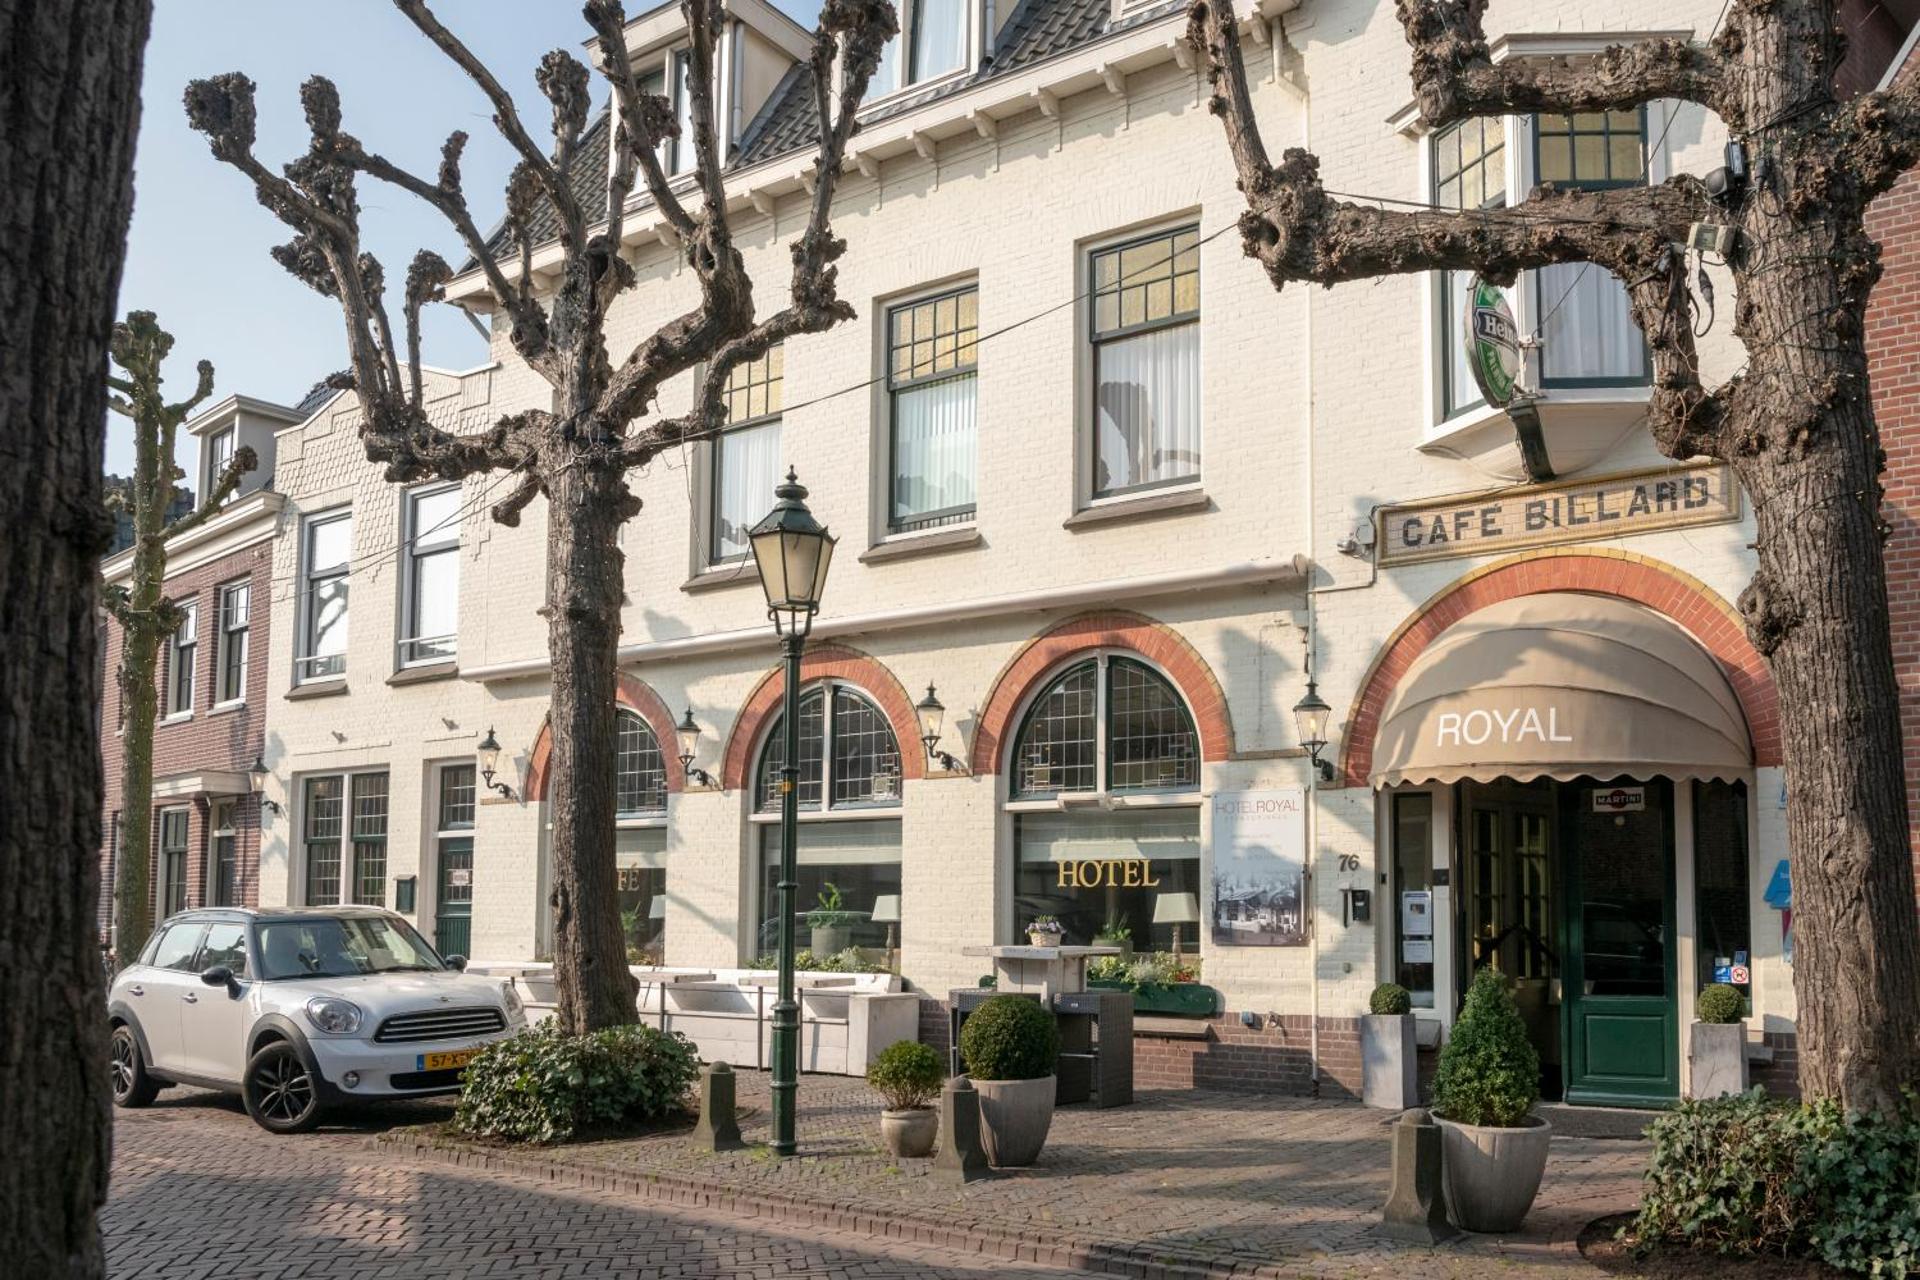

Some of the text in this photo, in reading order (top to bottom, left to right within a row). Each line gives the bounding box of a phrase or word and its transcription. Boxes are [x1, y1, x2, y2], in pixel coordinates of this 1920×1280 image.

[1525, 476, 1708, 532] BILLARD
[1437, 706, 1573, 747] ROYAL
[1598, 794, 1640, 804] MARTINI
[1056, 858, 1160, 888] HOTEL
[1338, 854, 1360, 873] 76
